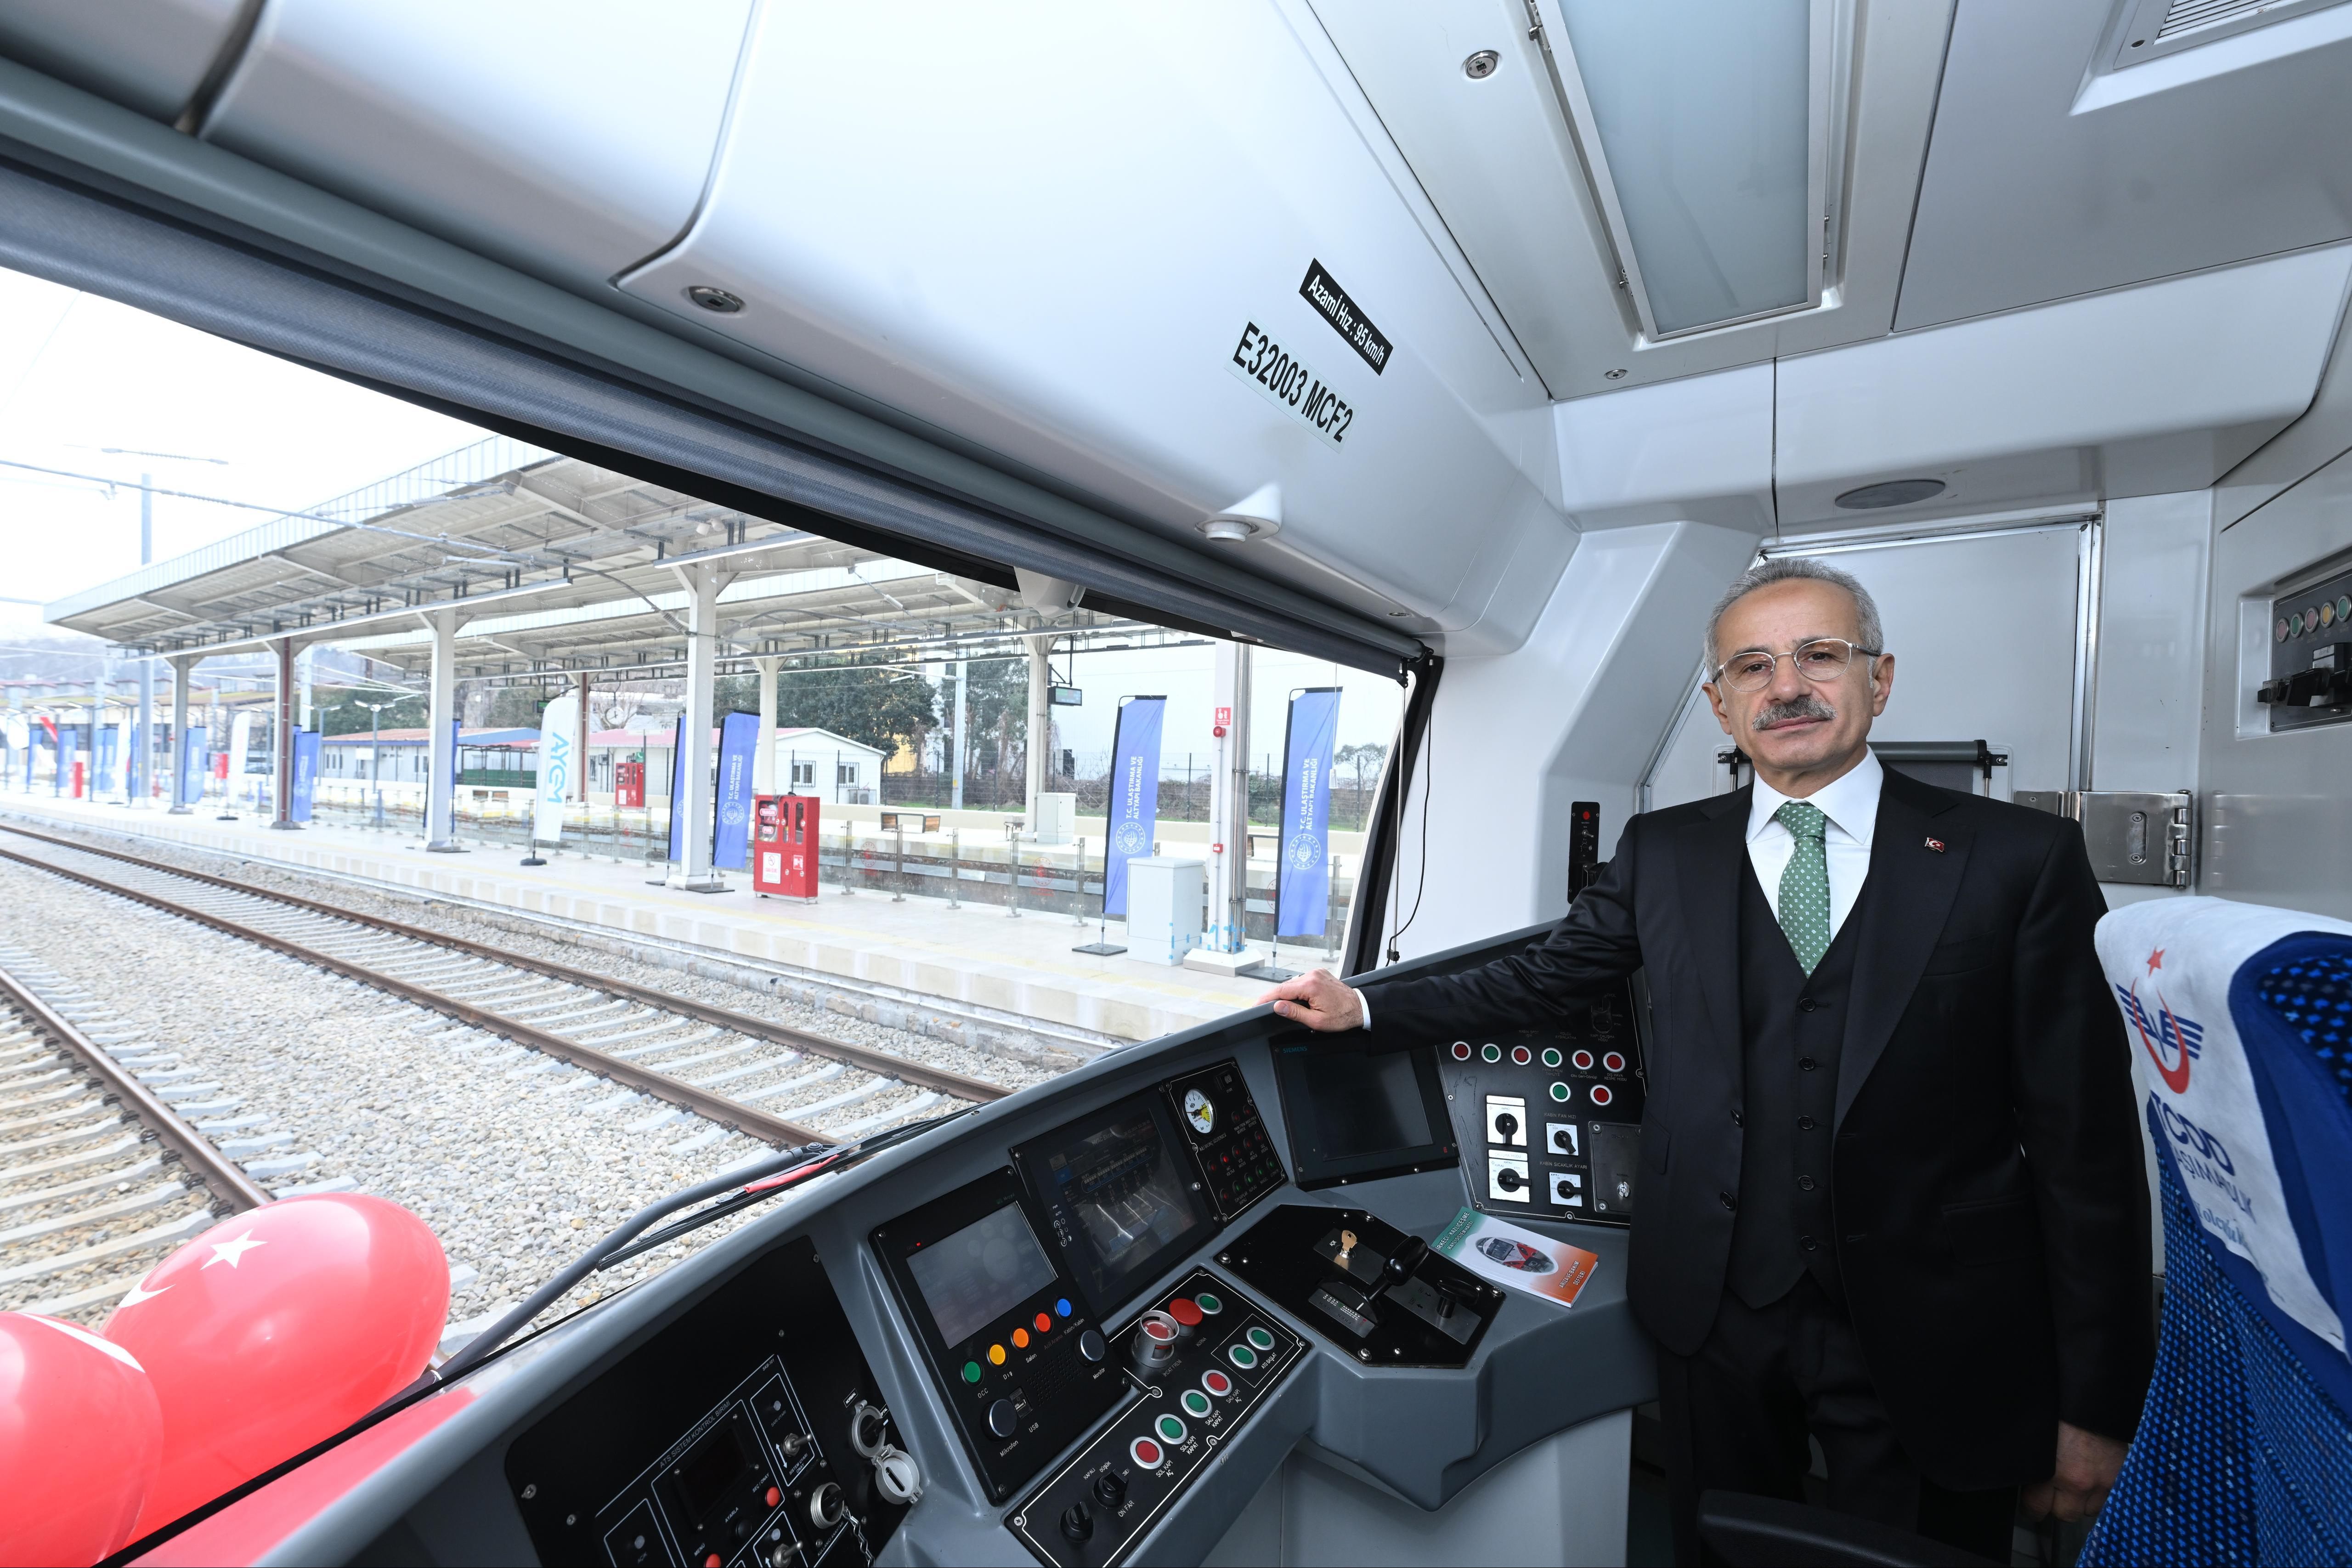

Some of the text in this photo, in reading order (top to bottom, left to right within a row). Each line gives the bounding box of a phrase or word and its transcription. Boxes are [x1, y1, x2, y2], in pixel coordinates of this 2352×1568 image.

[1336, 303, 1353, 332] Hız
[1354, 323, 1368, 346] 95
[1363, 334, 1385, 365] km/h
[1233, 321, 1353, 443] E32003 MCF2
[1131, 756, 1136, 765] VE
[1303, 759, 1309, 768] VE
[1127, 766, 1136, 805] ULAŞTIRMA
[2150, 1090, 2235, 1176] TCDD
[1449, 1211, 1470, 1235] KAZLIÇEŞME
[1447, 1239, 1458, 1250] RAYLI
[1464, 1221, 1474, 1233] HATTI
[1559, 1276, 1568, 1289] ARIZA
[1570, 1261, 1580, 1273] BAKIM
[1573, 1271, 1586, 1285] DEFTERİ
[1063, 1318, 1085, 1335] Kabin/Kabin
[1195, 1337, 1207, 1347] KORNA
[762, 1358, 775, 1371] SKB-101
[1026, 1353, 1037, 1363] Salon
[1266, 1352, 1277, 1364] BAŞLAT
[845, 1392, 856, 1404] NORMAL
[978, 1387, 989, 1399] OCC
[1233, 1389, 1241, 1398] KAPI
[777, 1410, 787, 1421] UYARI
[1212, 1410, 1221, 1419] KAPI
[1029, 1422, 1039, 1433] USB
[1211, 1415, 1223, 1428] KAPAT
[660, 1400, 731, 1469] ATS SİSTEM KONTROL BİRİMİ
[1187, 1435, 1196, 1446] KAPI
[1000, 1440, 1019, 1458] Mikrofon
[1186, 1442, 1199, 1455] KAPAT
[789, 1452, 808, 1476] SİSTEM UYARI
[796, 1463, 805, 1474] ONAY
[1099, 1460, 1112, 1473] DÜŞÜK
[1156, 1460, 1173, 1477] SOL KAPI
[760, 1472, 770, 1485] ONAY
[1083, 1467, 1096, 1480] KAPALI
[725, 1506, 739, 1523] AYARLA
[1118, 1500, 1135, 1517] ÖN FAR
[694, 1542, 706, 1557] MENÜ
[818, 1538, 831, 1557] KULLANICI
